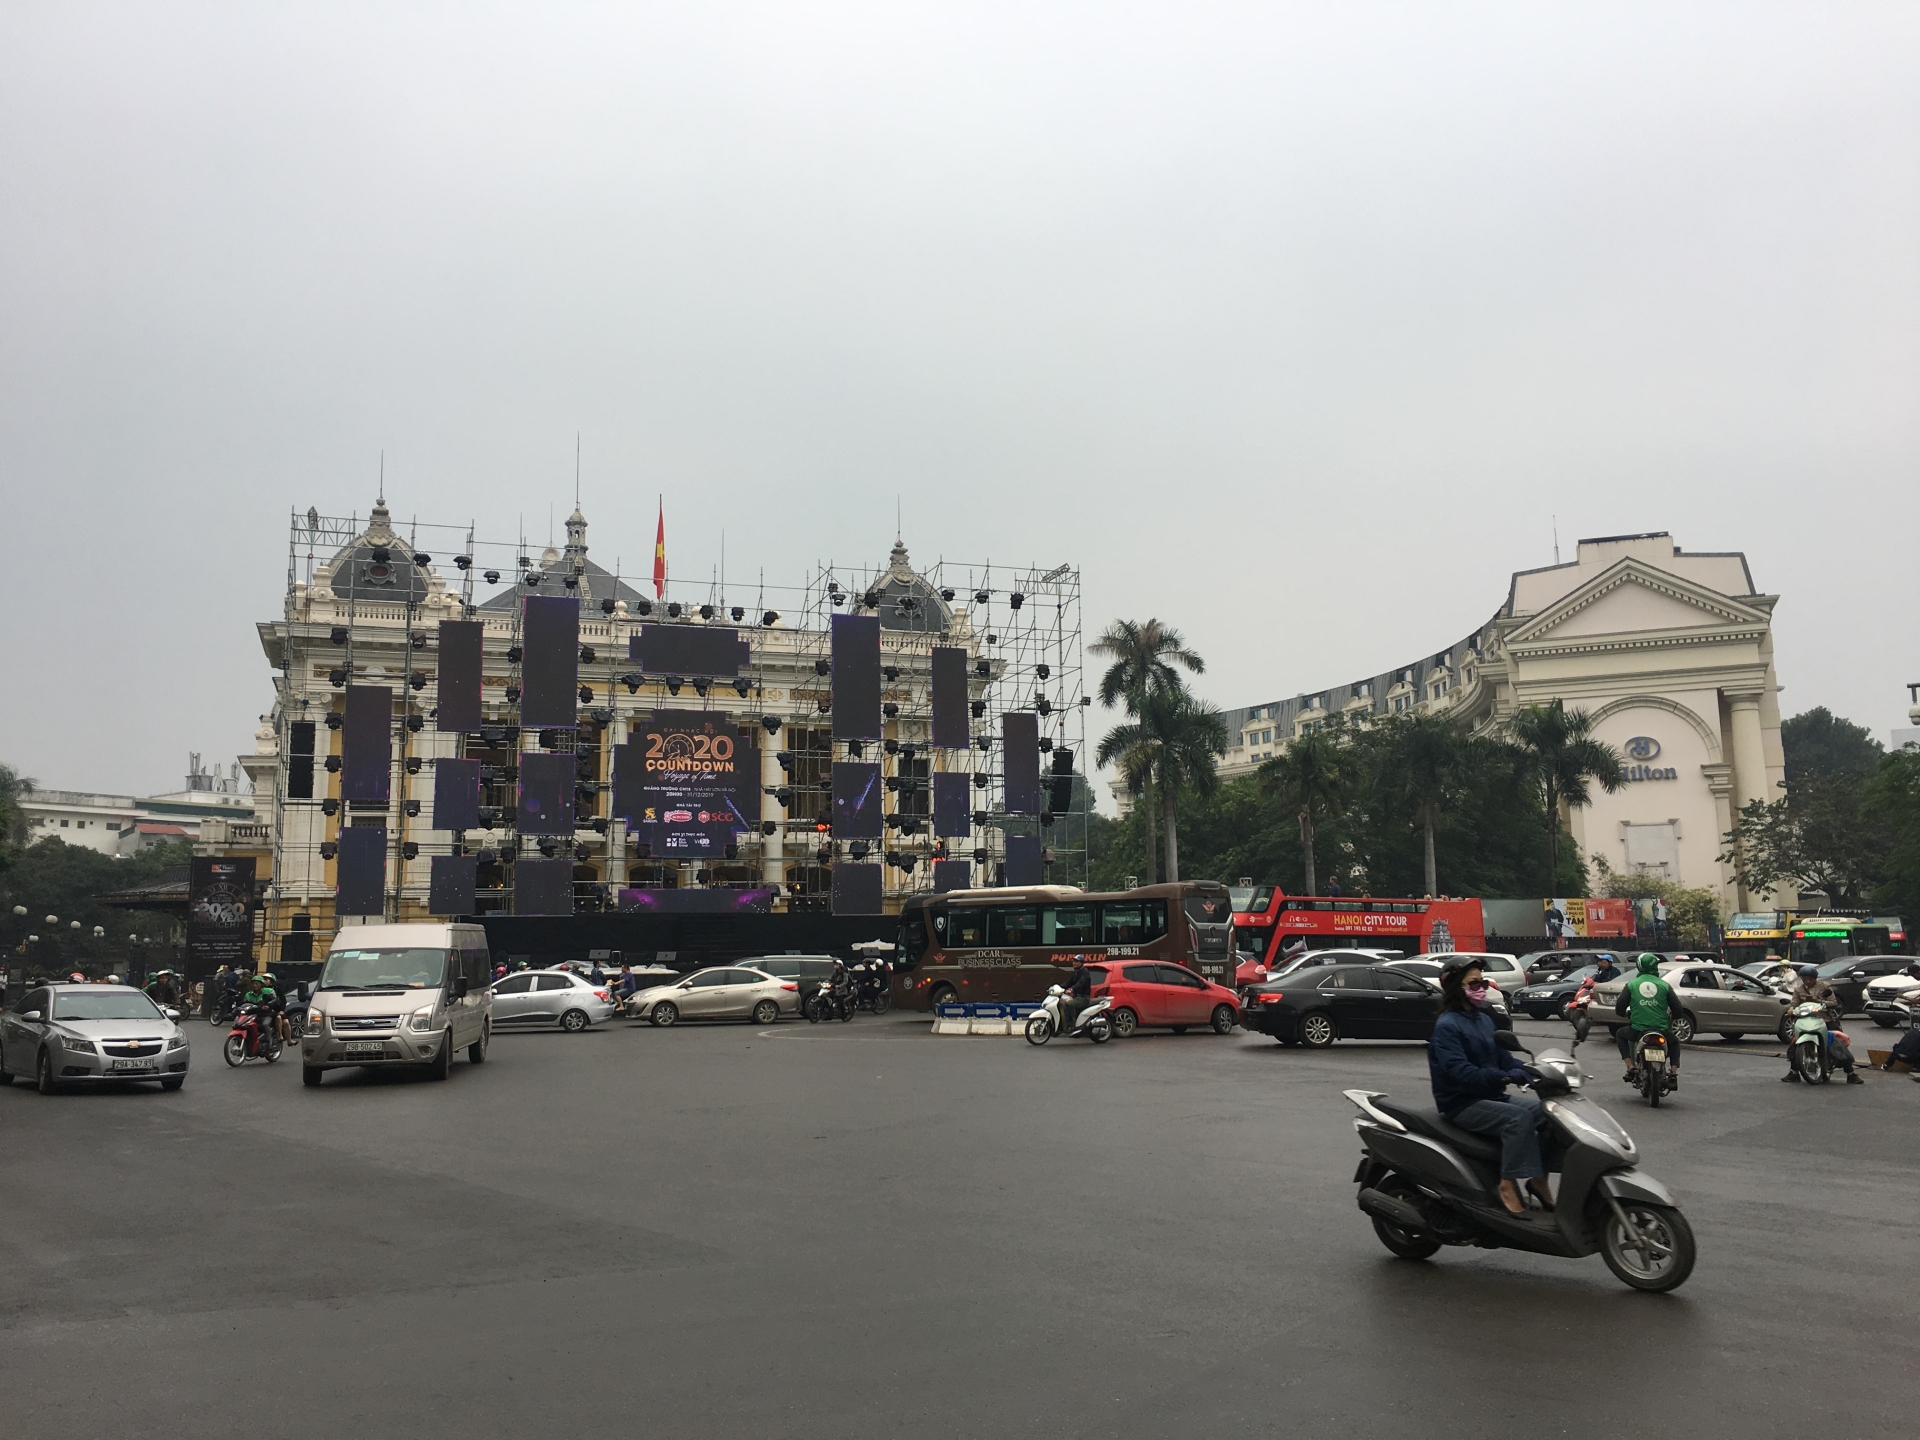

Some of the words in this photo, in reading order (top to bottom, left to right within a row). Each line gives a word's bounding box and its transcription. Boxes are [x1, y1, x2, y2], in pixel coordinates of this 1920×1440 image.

[645, 759, 734, 772] COUNTDOWN
[663, 769, 690, 782] Voyage
[691, 771, 700, 782] of
[700, 770, 717, 780] Time
[711, 812, 734, 822] SCG
[197, 902, 245, 917] 2020
[193, 914, 219, 922] NEW
[220, 914, 248, 922] YEAR
[1333, 915, 1362, 925] HANOI
[1364, 915, 1383, 925] CITY
[1385, 916, 1407, 926] TOUR
[978, 950, 1000, 958] DCAR
[1107, 947, 1139, 955] 29B-199.21
[958, 958, 995, 966] BUSINESS
[1051, 953, 1107, 962] PUMKIN
